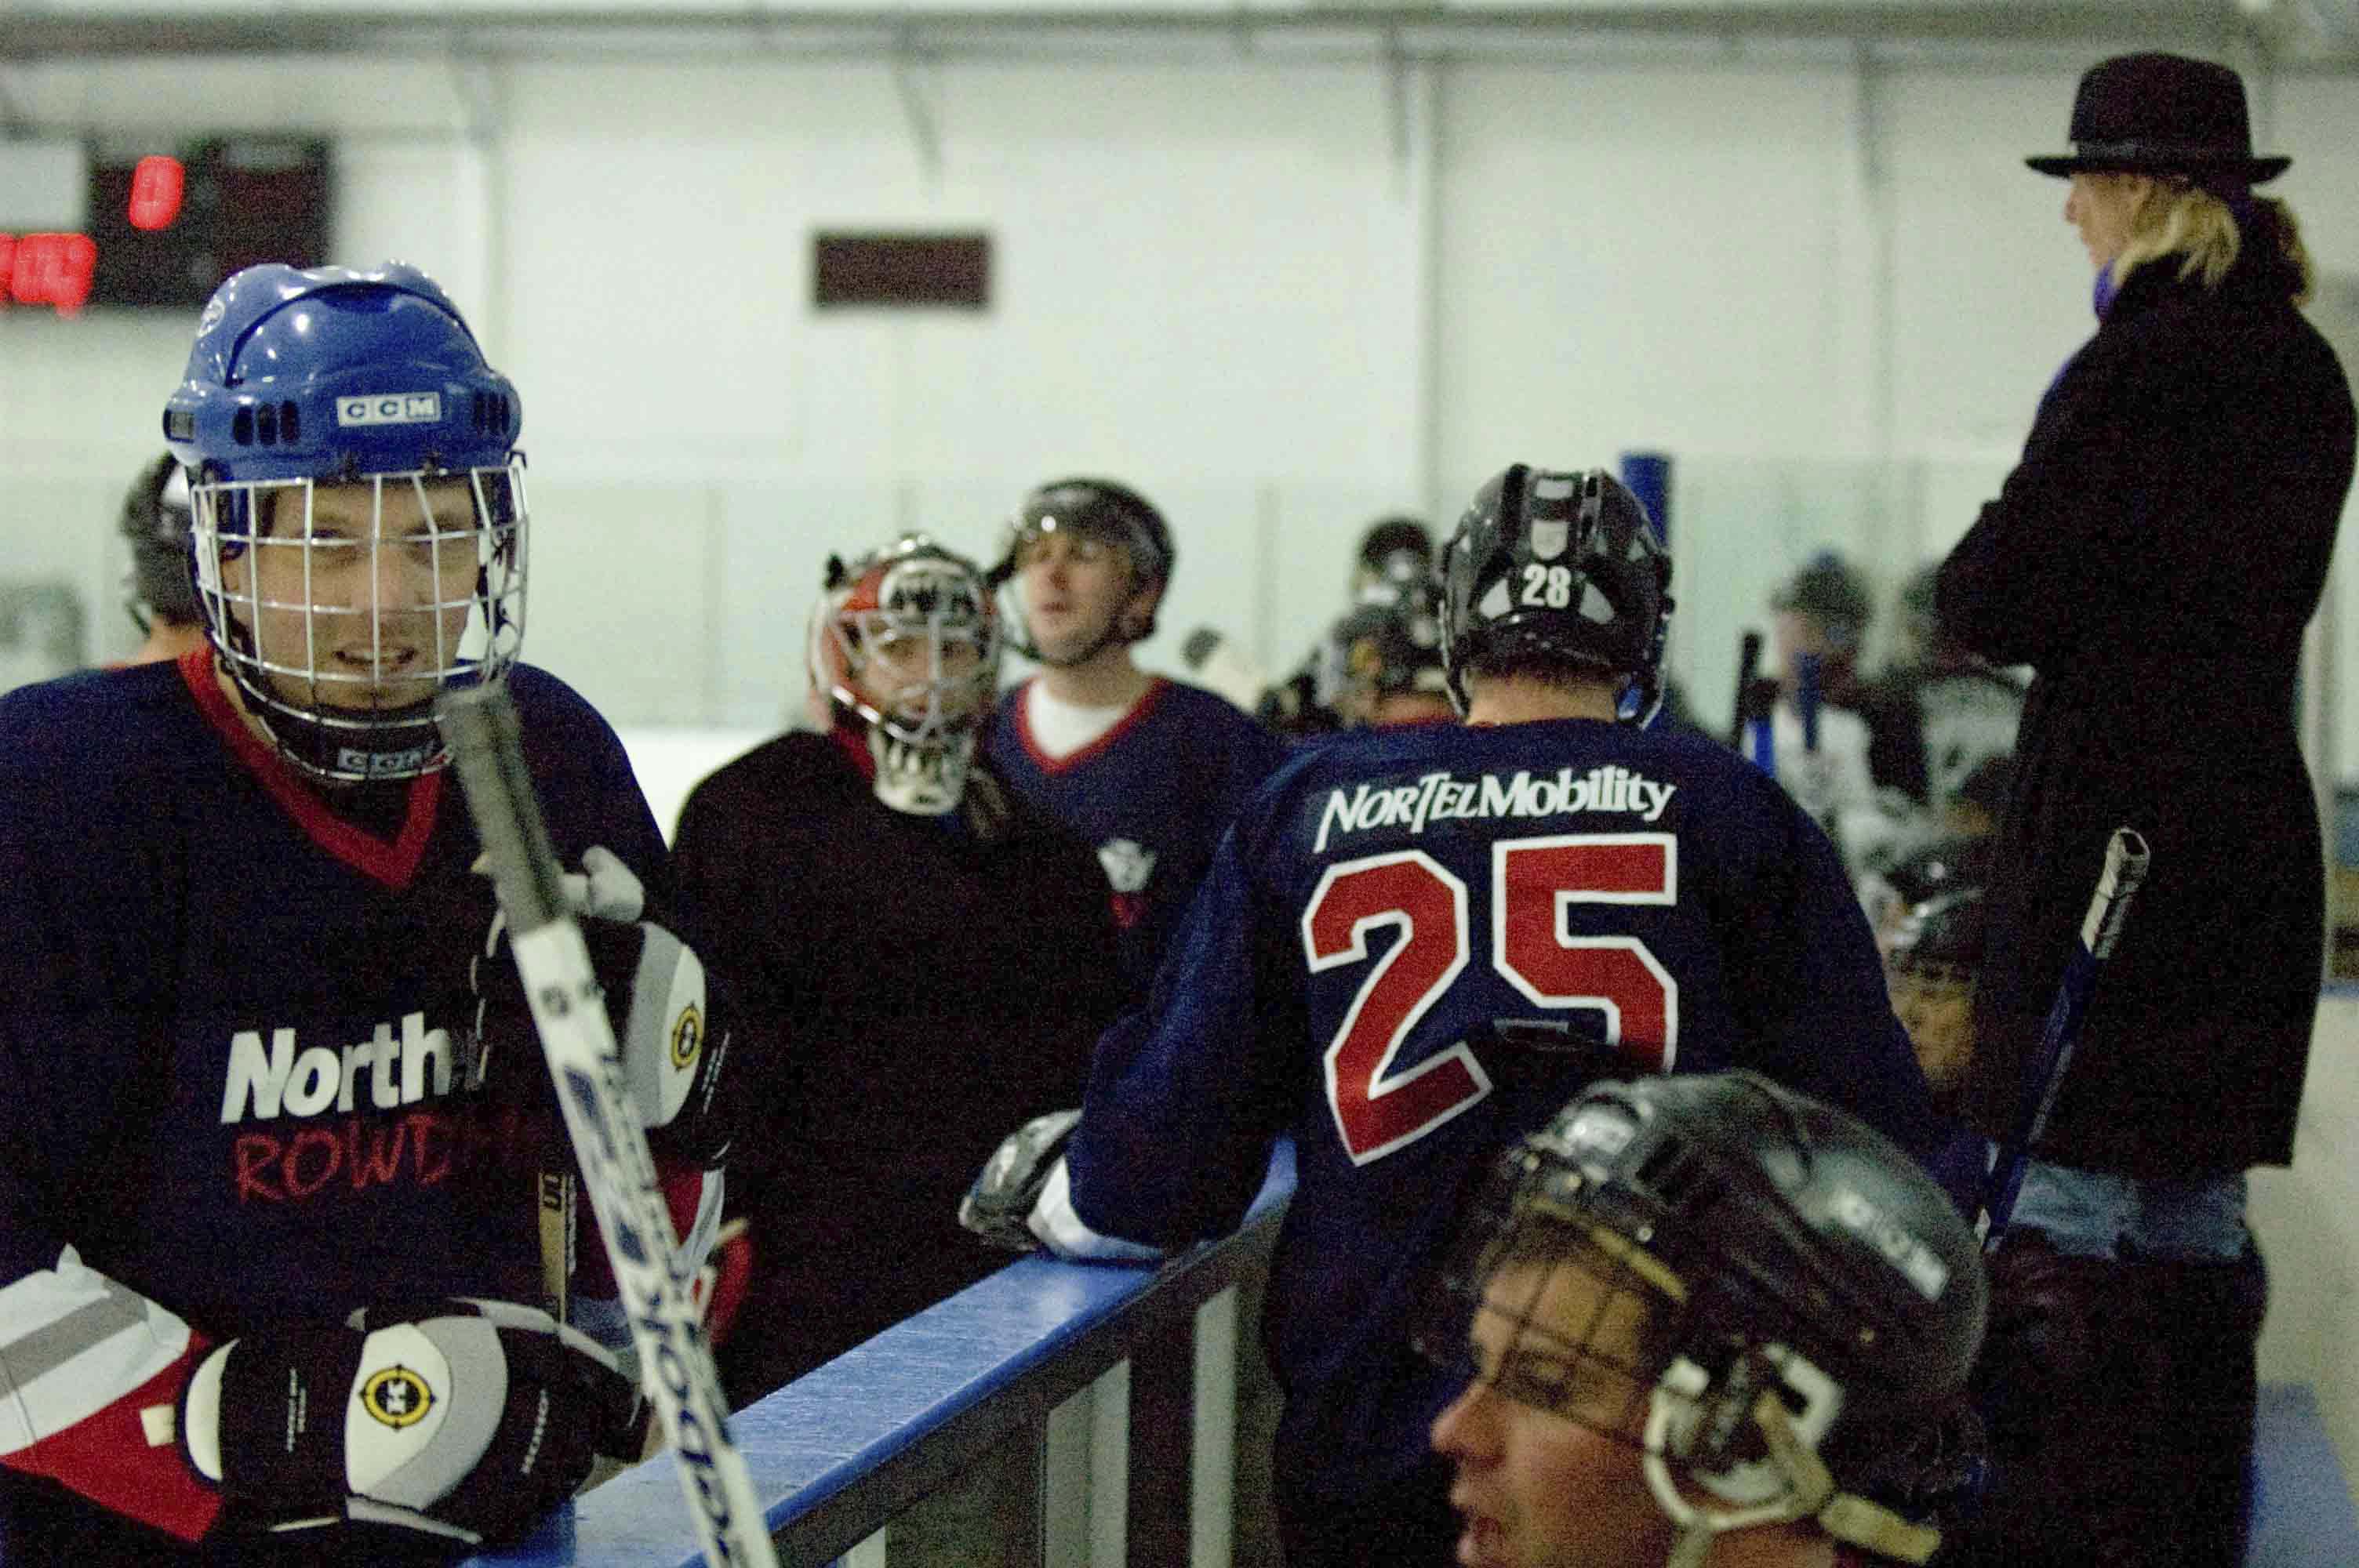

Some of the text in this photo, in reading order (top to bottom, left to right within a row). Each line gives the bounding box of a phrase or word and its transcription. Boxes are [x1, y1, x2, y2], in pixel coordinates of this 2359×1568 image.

[347, 395, 437, 419] CCM
[1522, 563, 1572, 608] 28
[1302, 833, 1678, 1167] 25
